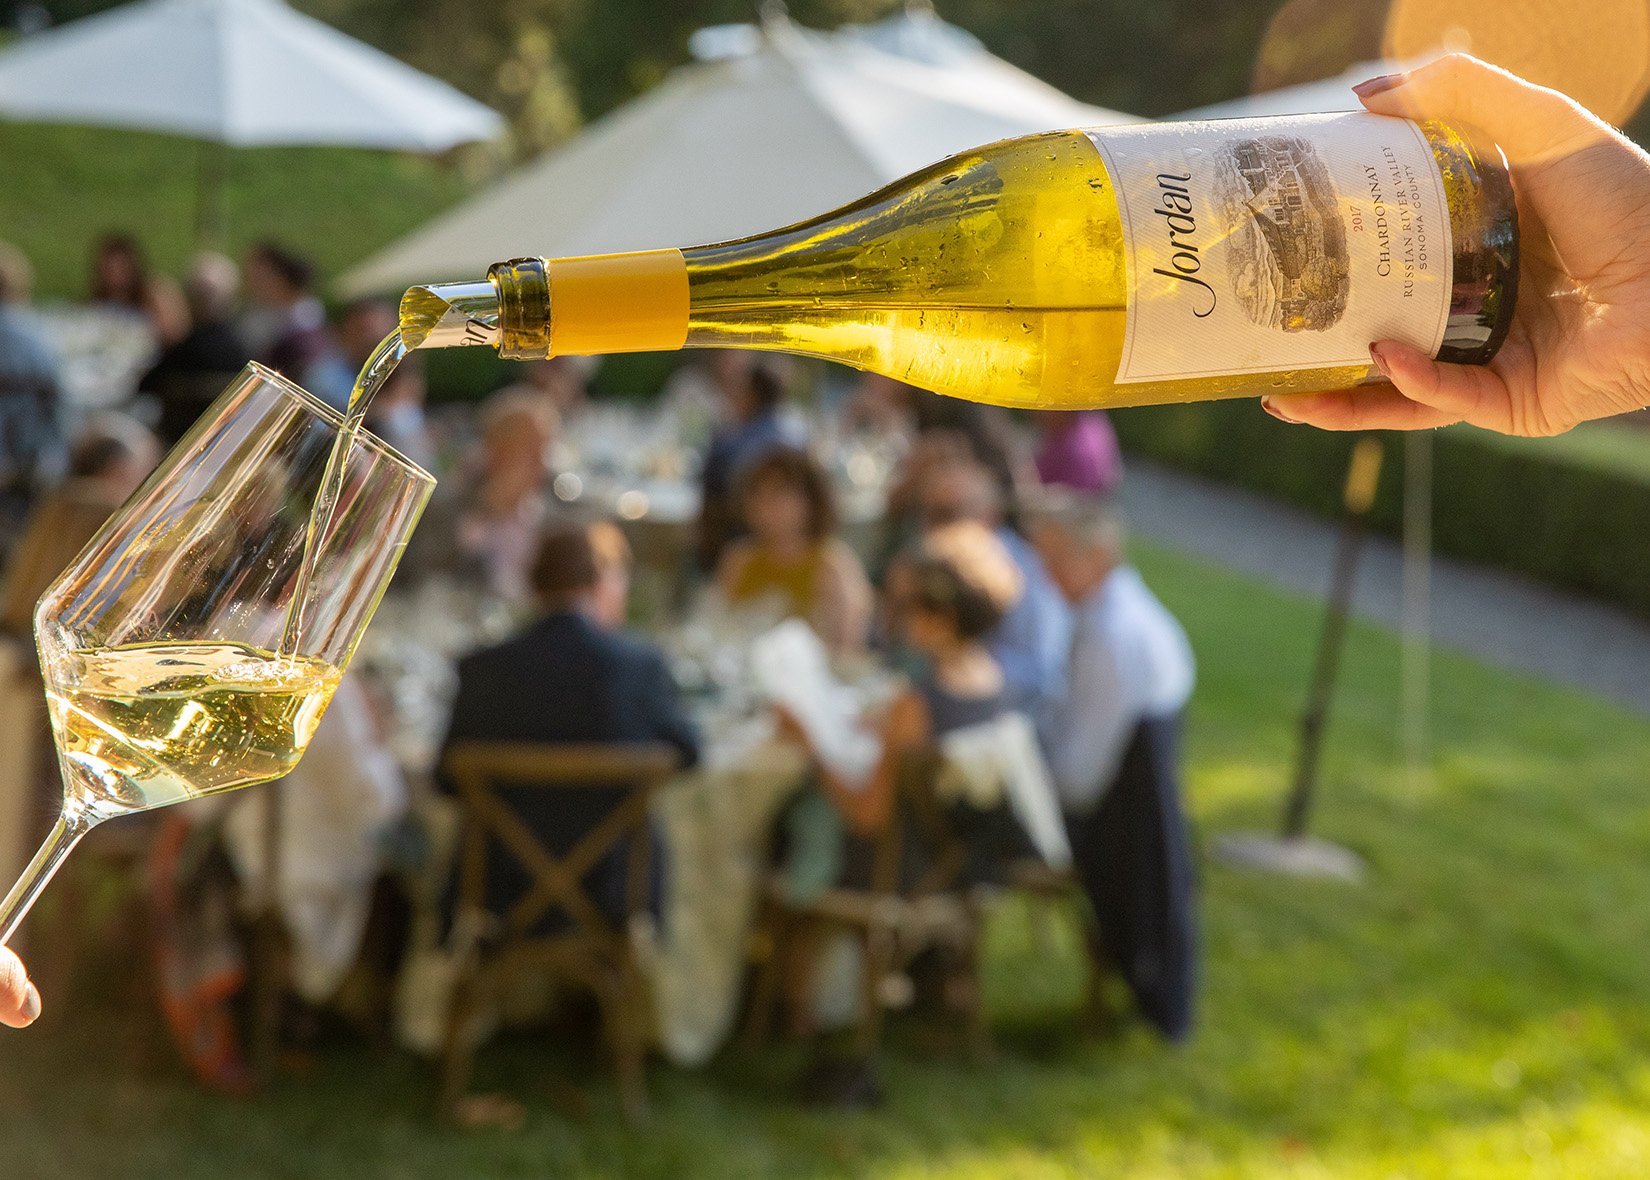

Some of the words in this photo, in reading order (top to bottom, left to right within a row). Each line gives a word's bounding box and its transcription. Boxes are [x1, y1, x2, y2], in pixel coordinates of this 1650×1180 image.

[1382, 145, 1402, 186] VALLEY
[1404, 165, 1422, 209] COUNTY
[1350, 206, 1364, 232] 2017
[1363, 164, 1391, 277] CHARDONNAY
[1396, 190, 1412, 231] RIVER
[1153, 173, 1217, 318] Jordan
[1416, 215, 1428, 270] SONOMA
[1404, 237, 1415, 298] RUSSIAN
